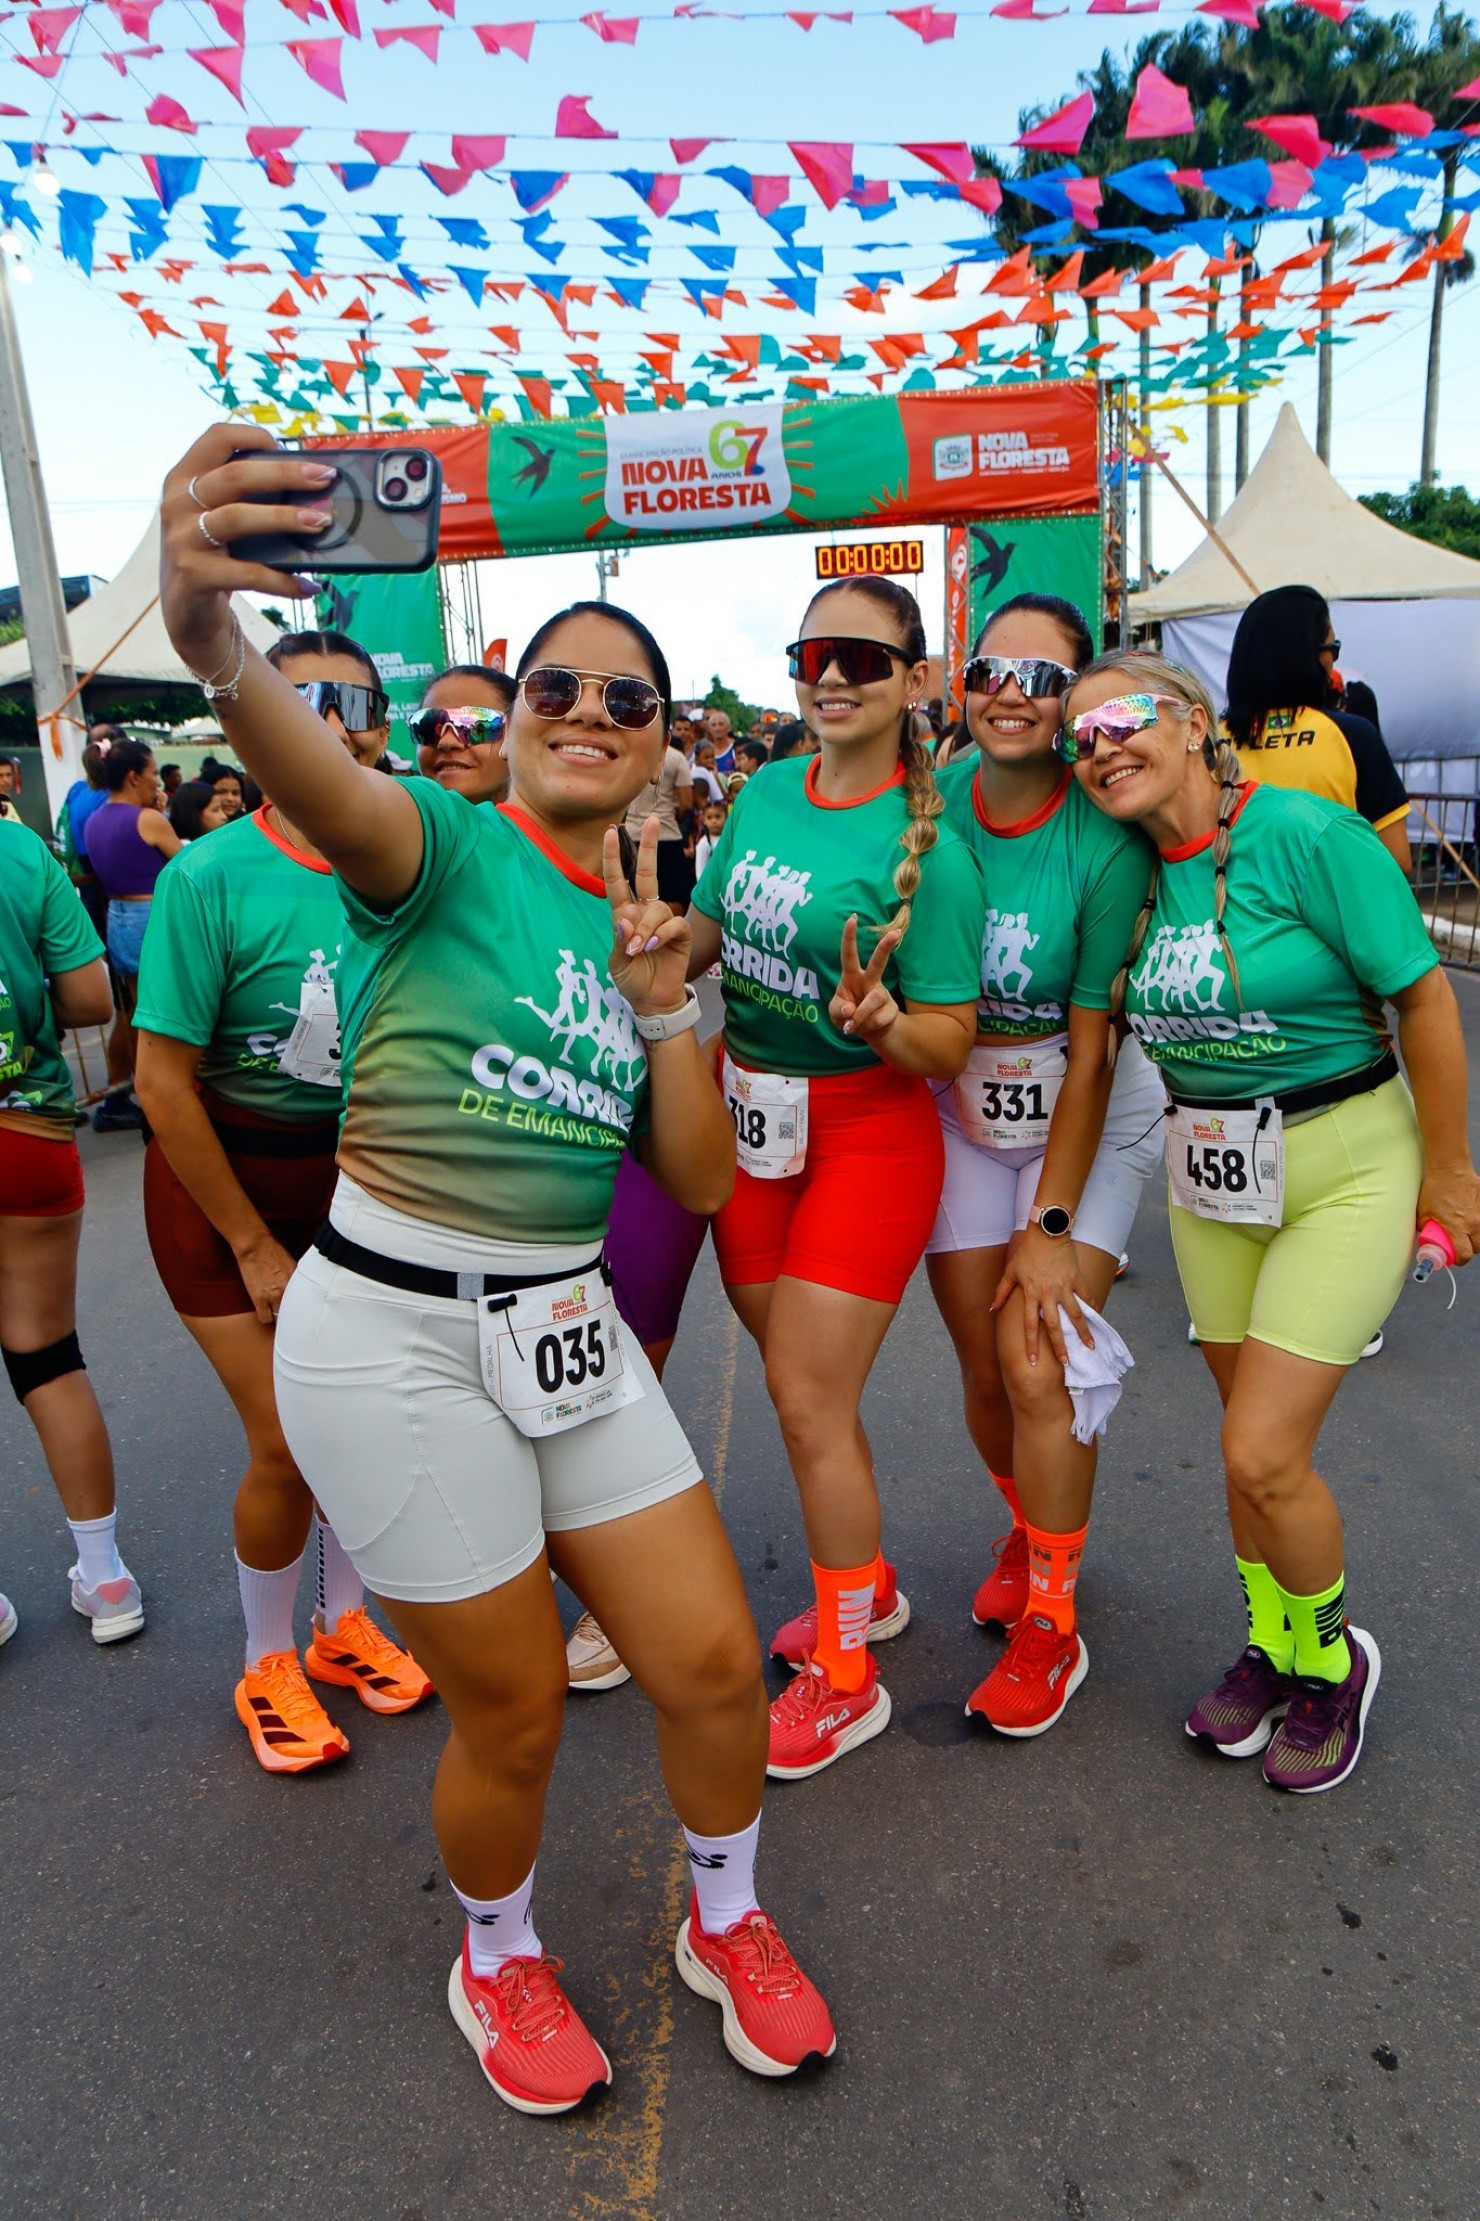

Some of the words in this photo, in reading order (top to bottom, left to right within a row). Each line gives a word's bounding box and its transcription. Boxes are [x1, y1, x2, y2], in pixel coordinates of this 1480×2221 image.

[709, 420, 768, 477] 67
[978, 431, 1029, 451] NOVA
[978, 446, 1071, 470] FLORESTA
[621, 457, 708, 486] NOVA
[711, 471, 742, 480] ANOS
[624, 482, 772, 515] FLORESTA
[818, 541, 921, 576] 00:00:00
[1125, 1009, 1279, 1044] ORRIDA
[997, 1063, 1017, 1071] NOVA
[997, 1069, 1032, 1077] FLORESTA
[1017, 1056, 1033, 1070] 67
[458, 1088, 504, 1122] DE
[981, 1081, 1048, 1122] 331
[1193, 1123, 1211, 1133] NOVA
[1193, 1131, 1226, 1141] FLORESTA
[1210, 1117, 1225, 1133] 67
[1187, 1144, 1248, 1193] 458
[552, 1299, 575, 1312] NOVA
[572, 1284, 586, 1302] 67
[552, 1303, 588, 1321] FLORESTA
[486, 1345, 494, 1378] MEDALHA
[535, 1319, 606, 1394] 035
[815, 1707, 851, 1739] FILA
[474, 1999, 499, 2050] FILA
